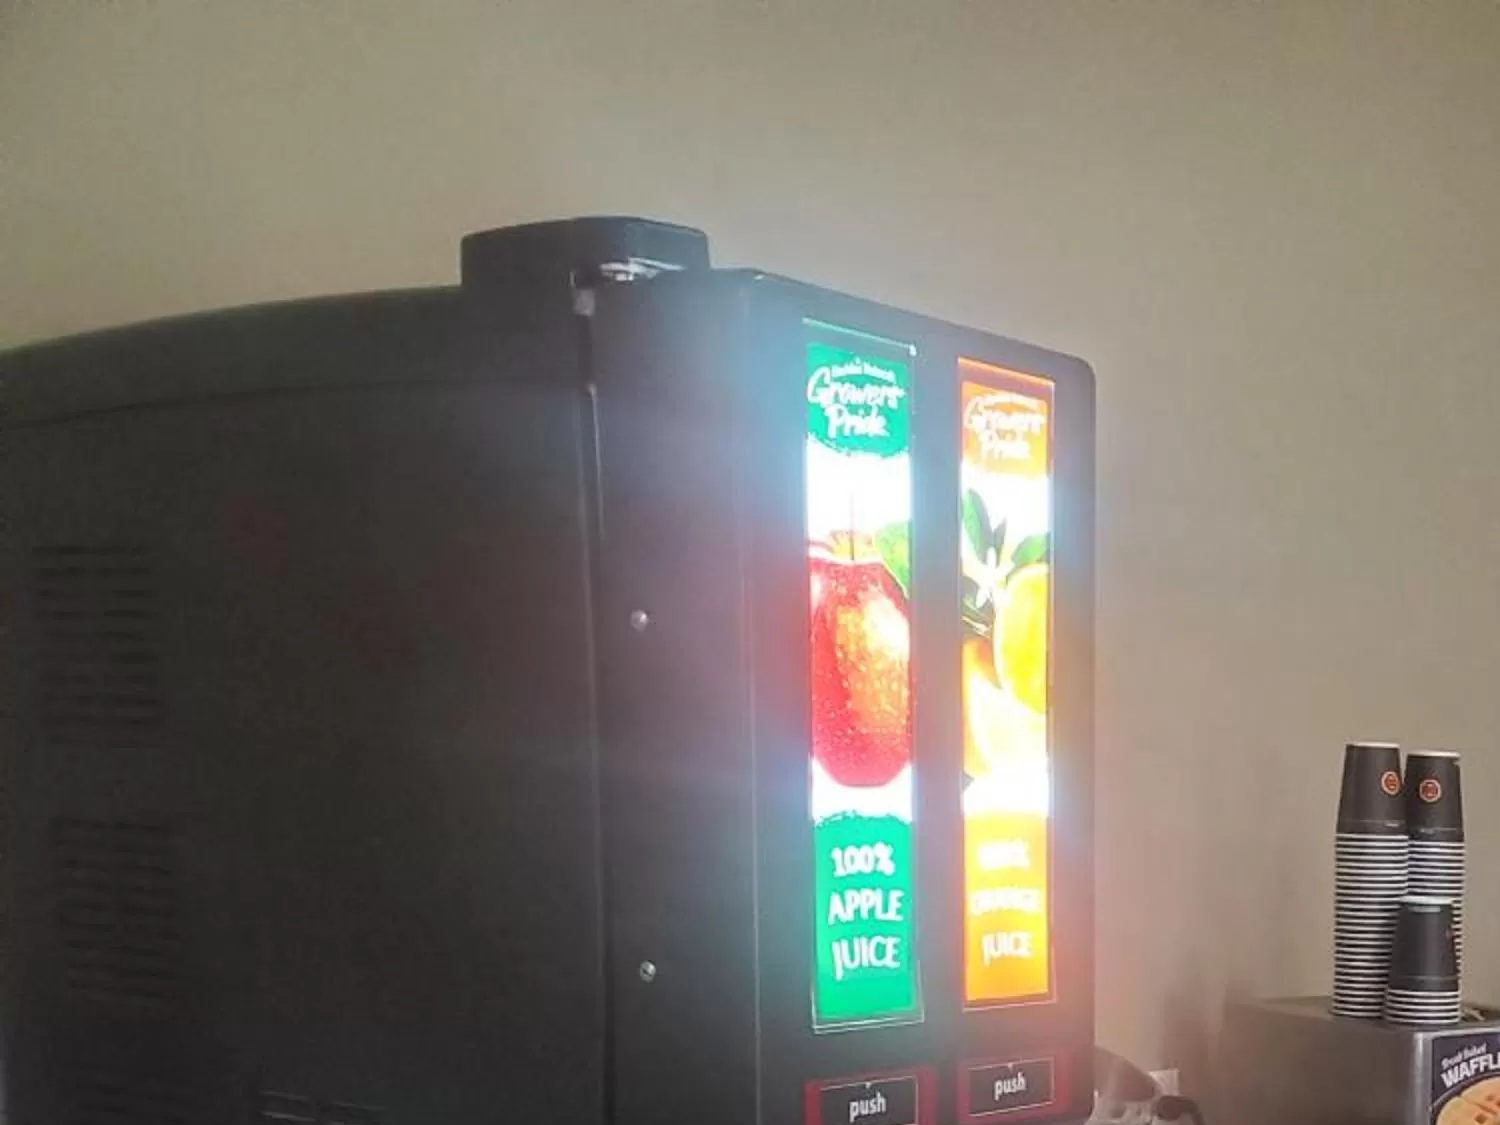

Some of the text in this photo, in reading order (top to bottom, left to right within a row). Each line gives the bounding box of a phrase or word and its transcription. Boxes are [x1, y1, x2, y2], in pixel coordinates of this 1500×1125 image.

[831, 841, 895, 877] 100%
[827, 887, 904, 925] APPLE
[831, 935, 901, 981] JUICE
[982, 931, 1033, 966] JUICE
[994, 1071, 1026, 1101] push
[849, 1091, 887, 1122] push
